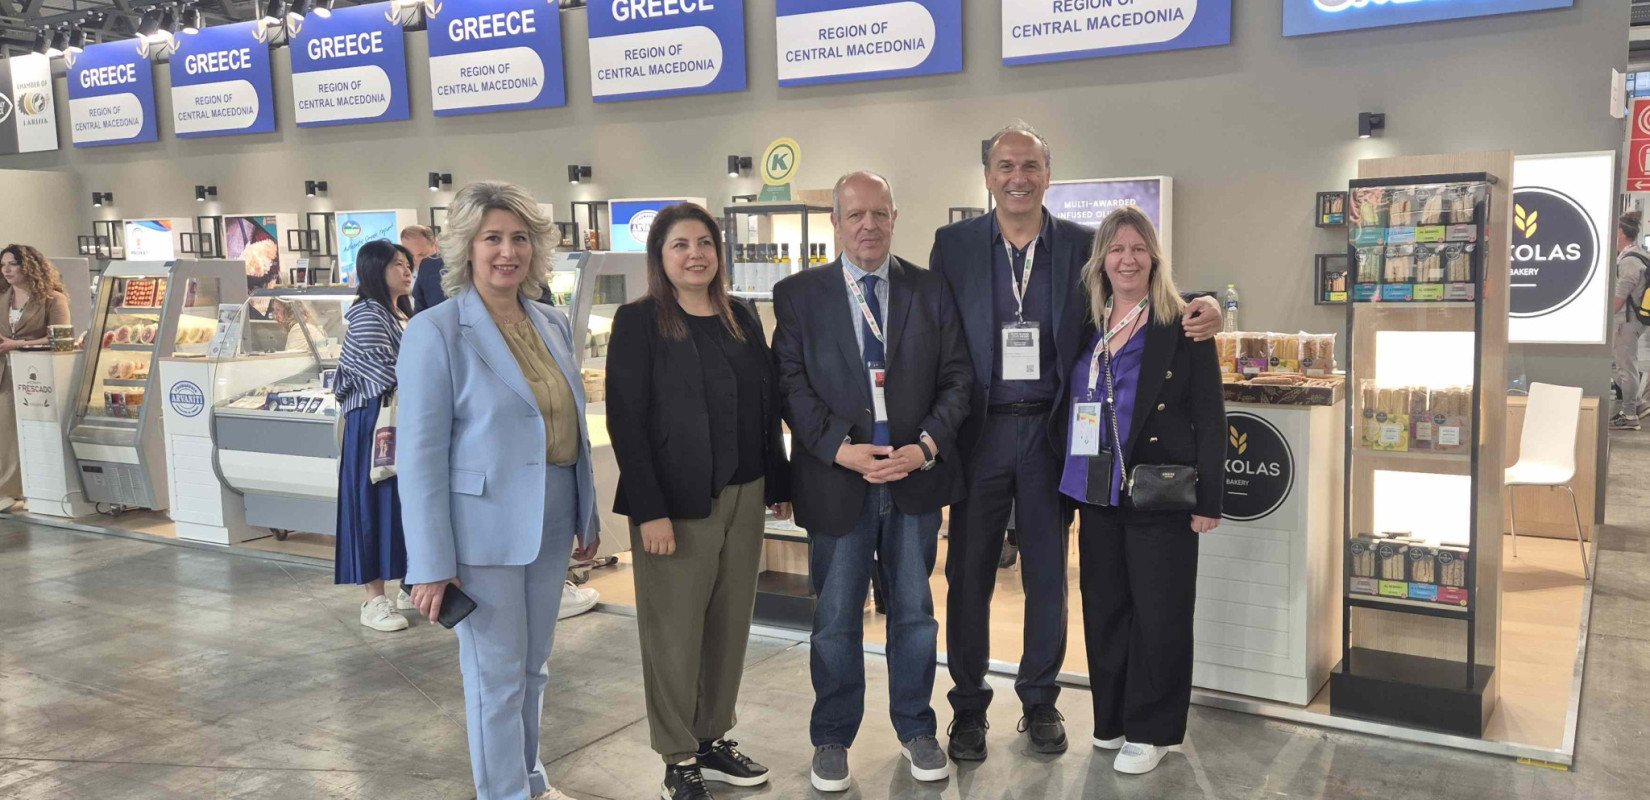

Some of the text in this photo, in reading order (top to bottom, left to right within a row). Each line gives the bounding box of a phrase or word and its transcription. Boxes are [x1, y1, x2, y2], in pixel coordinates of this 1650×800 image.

[448, 9, 536, 42] GREECE
[818, 21, 888, 40] REGION OF
[1012, 7, 1184, 39] CENTRAL MACEDONIA
[308, 30, 383, 60] GREECE
[624, 44, 683, 60] REGION OF
[785, 37, 925, 62] CENTRAL MACEDONIA
[185, 48, 251, 75] GREECE
[597, 59, 715, 80] CENTRAL MACEDONIA
[80, 63, 136, 88] GREECE
[460, 63, 510, 78] REGION OF
[318, 80, 362, 93] REGION OF
[437, 77, 538, 96] CENTRAL MACEDONIA
[195, 93, 232, 105] REGION OF
[299, 93, 386, 110] CENTRAL MACEDONIA
[89, 106, 120, 117] REGION OF
[178, 106, 254, 121] CENTRAL MACEDONIA
[75, 117, 139, 132] CENTRAL MACEDONIA
[771, 153, 789, 171] K
[1064, 199, 1136, 209] MULTI-AWARDED
[1057, 211, 1093, 220] INFUSED
[18, 384, 52, 395] FRESCADO
[1225, 478, 1249, 486] BAKERY
